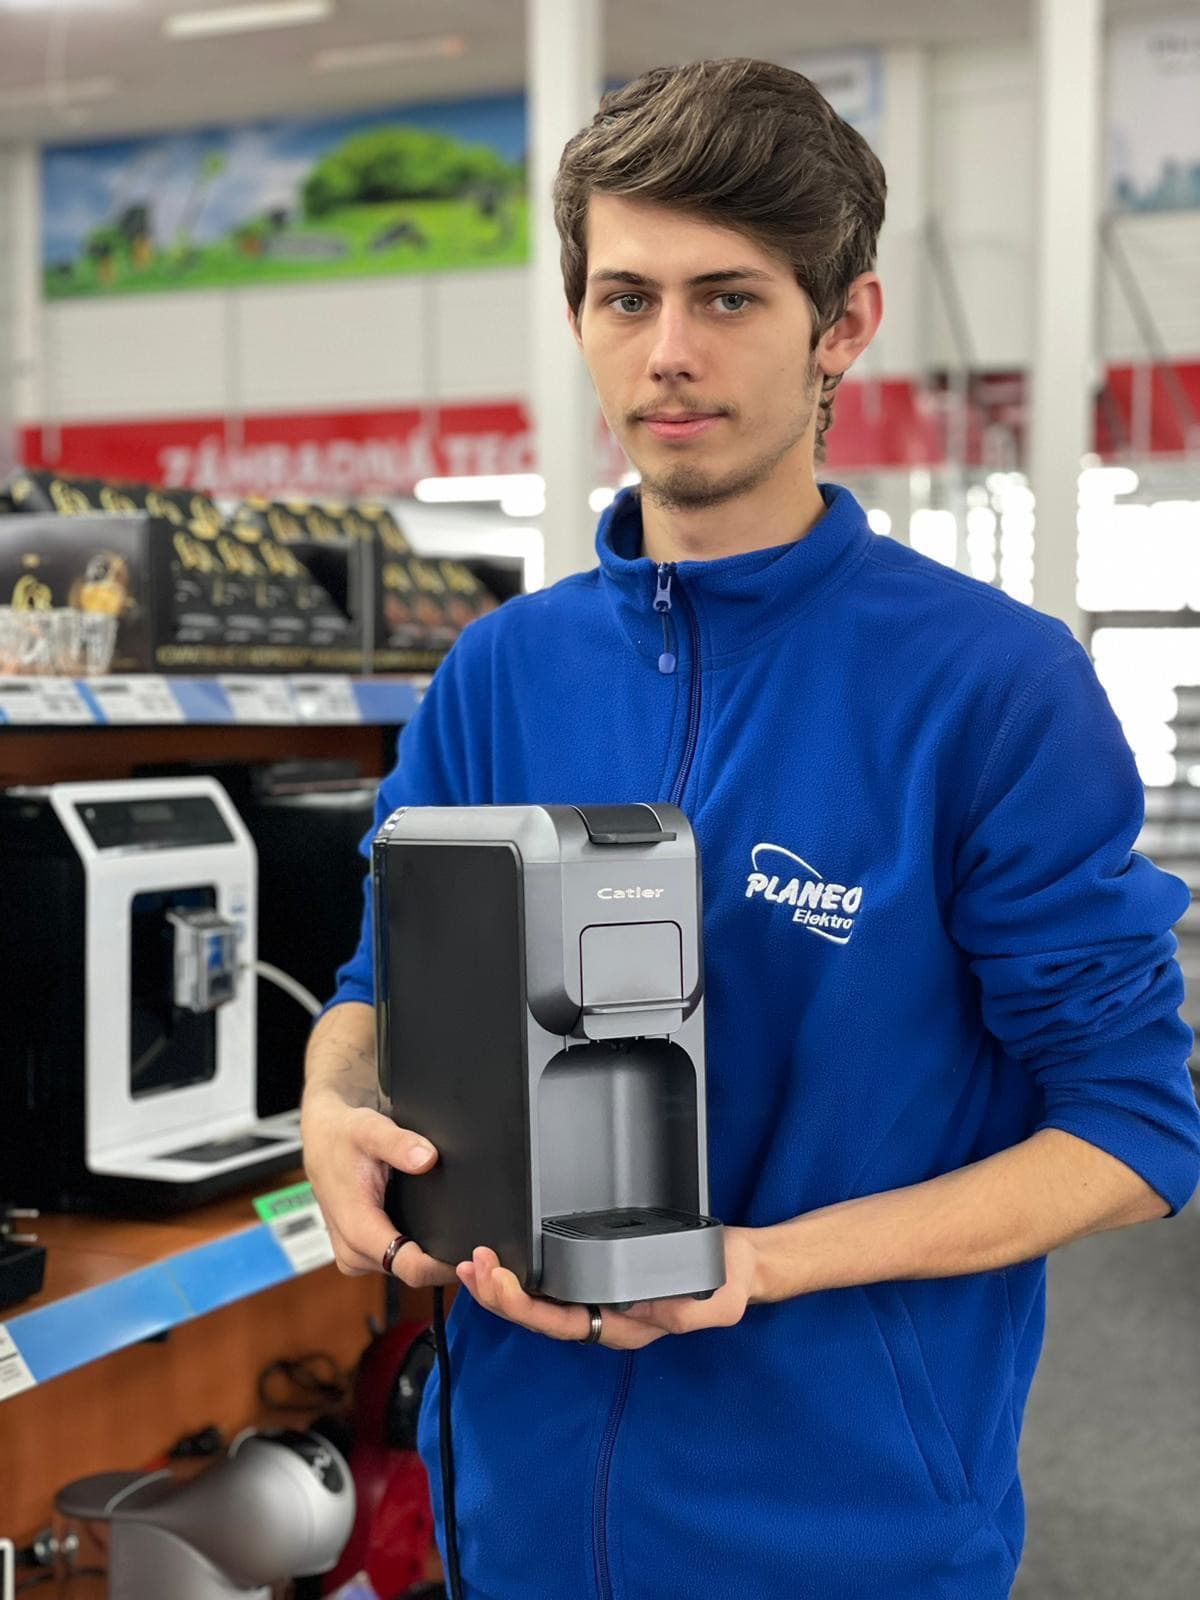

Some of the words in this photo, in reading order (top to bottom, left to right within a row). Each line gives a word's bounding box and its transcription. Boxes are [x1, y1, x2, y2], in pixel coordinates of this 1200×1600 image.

[597, 886, 664, 900] Catler
[745, 873, 862, 914] PLANEO
[792, 908, 853, 930] Elektro
